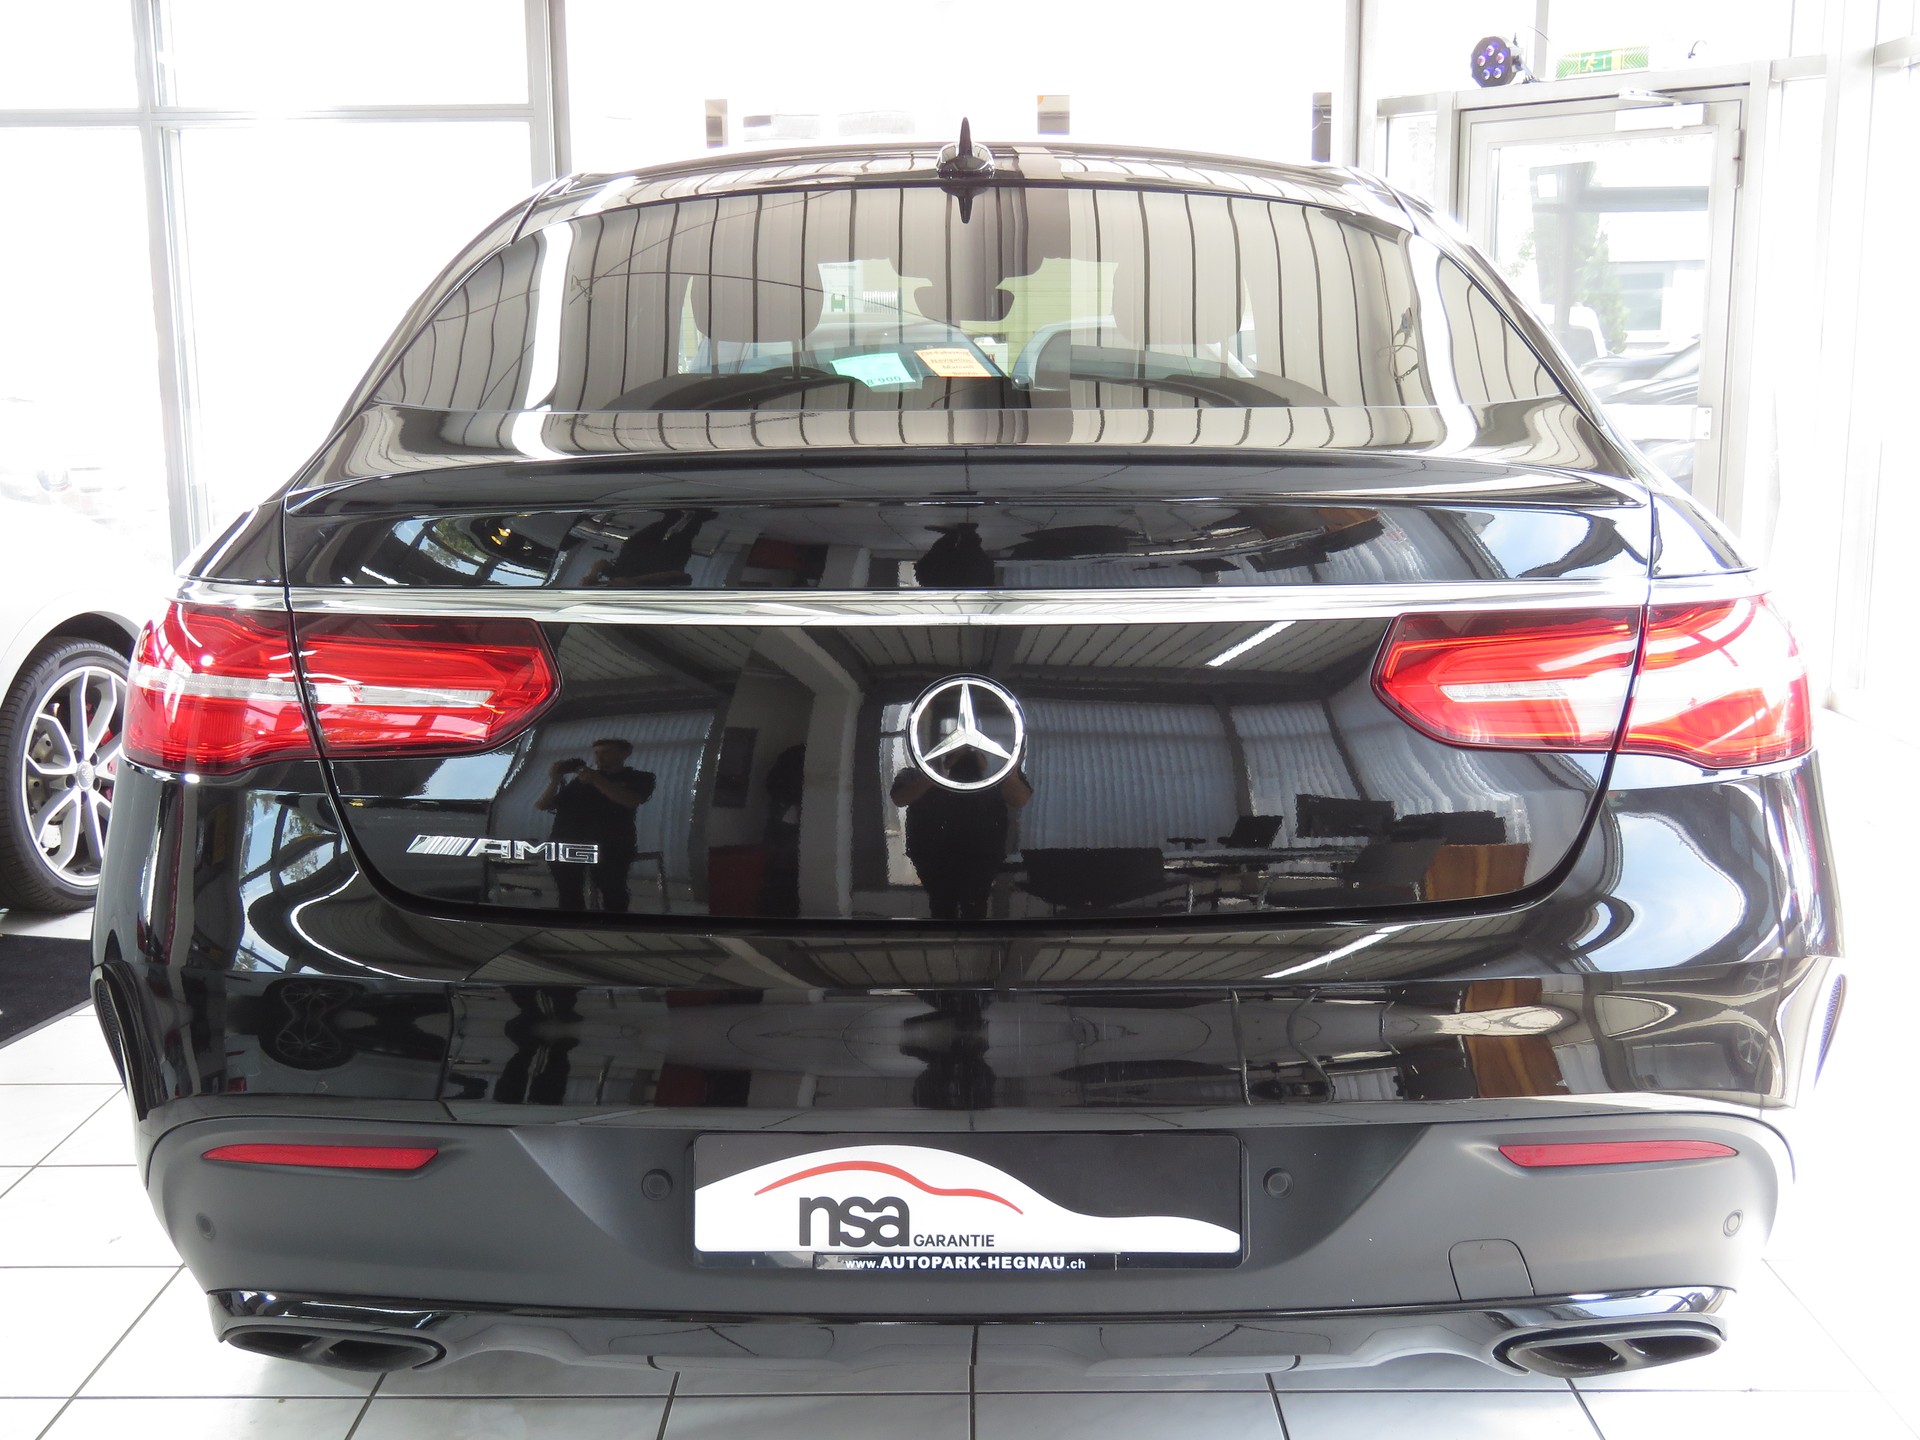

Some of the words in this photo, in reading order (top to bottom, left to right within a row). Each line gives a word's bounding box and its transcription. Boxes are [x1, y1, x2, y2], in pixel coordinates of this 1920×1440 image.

[467, 838, 599, 864] AMG
[799, 1196, 910, 1248] nsa
[913, 1234, 995, 1247] GARANTIE
[845, 1256, 1086, 1270] www.AUTOPARK-HEGNAU.ch
